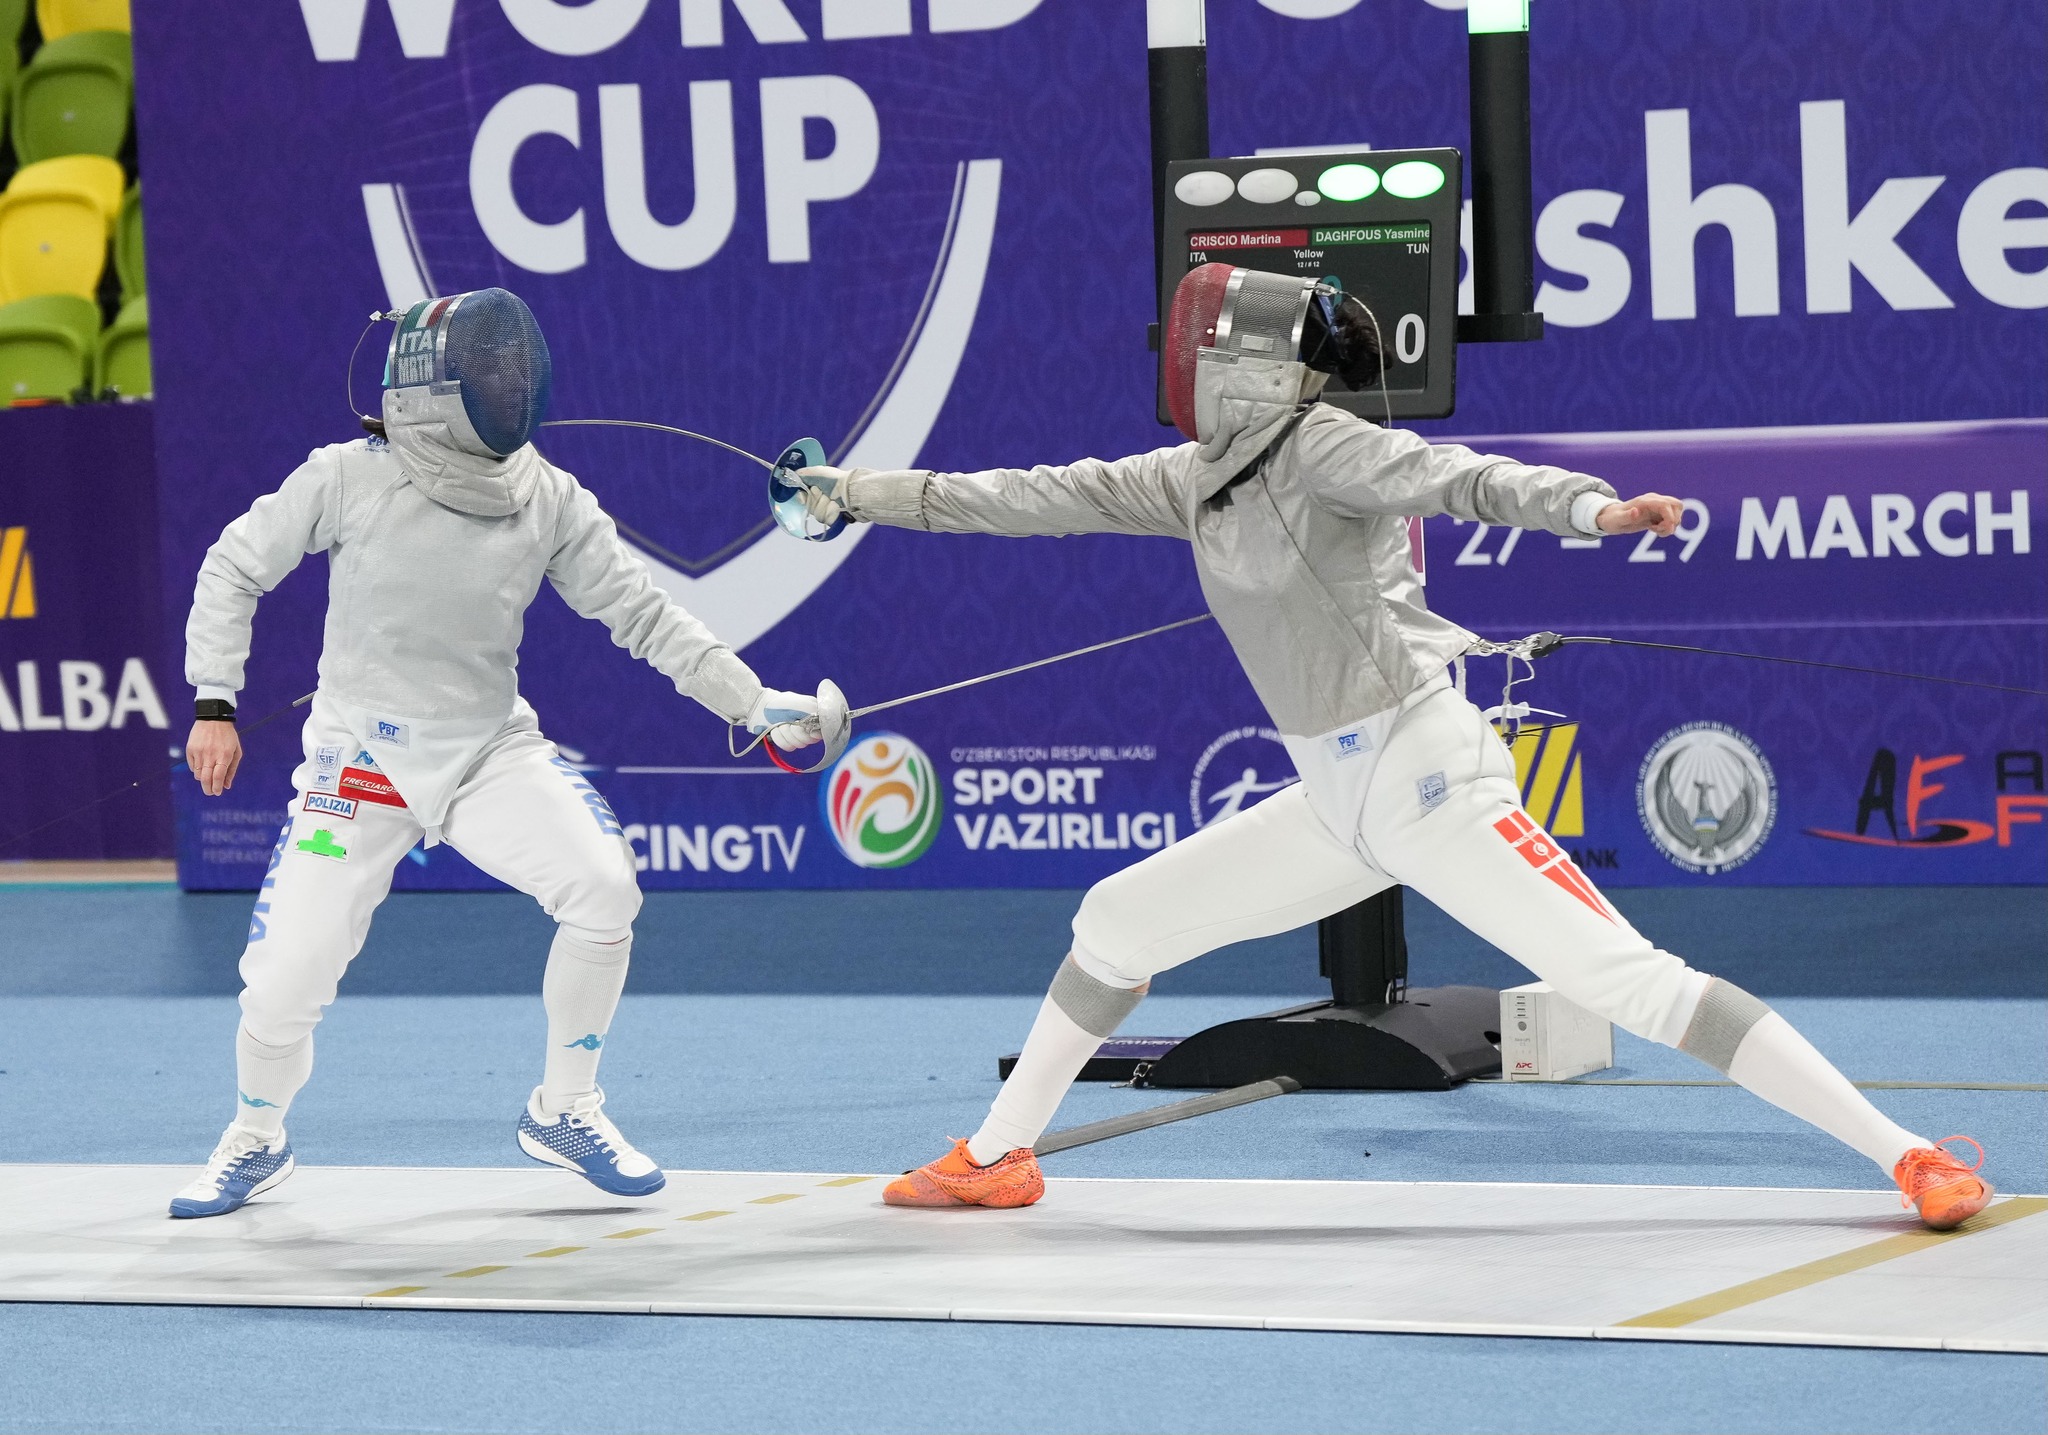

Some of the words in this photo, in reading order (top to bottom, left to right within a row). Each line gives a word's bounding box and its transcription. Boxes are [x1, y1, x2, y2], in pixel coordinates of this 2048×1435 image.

[469, 74, 880, 274] CUP
[1254, 100, 2048, 328] shke
[1190, 234, 1238, 247] CRISCIO
[1240, 233, 1281, 246] Martina
[1315, 229, 1382, 243] DAGHFOUS
[1383, 227, 1430, 241] Yasmine
[1189, 251, 1207, 263] ITA
[1293, 249, 1324, 259] Yellow
[1406, 243, 1430, 255] TUN
[400, 329, 433, 354] ITA
[1396, 313, 1426, 364] 0
[1735, 489, 2031, 561] MARCH
[378, 721, 400, 737] PBT
[1338, 733, 1359, 749] PBT
[952, 767, 1104, 806] SPORT
[307, 796, 352, 815] POLIZIA
[953, 811, 1177, 851] VAZIRLIGI
